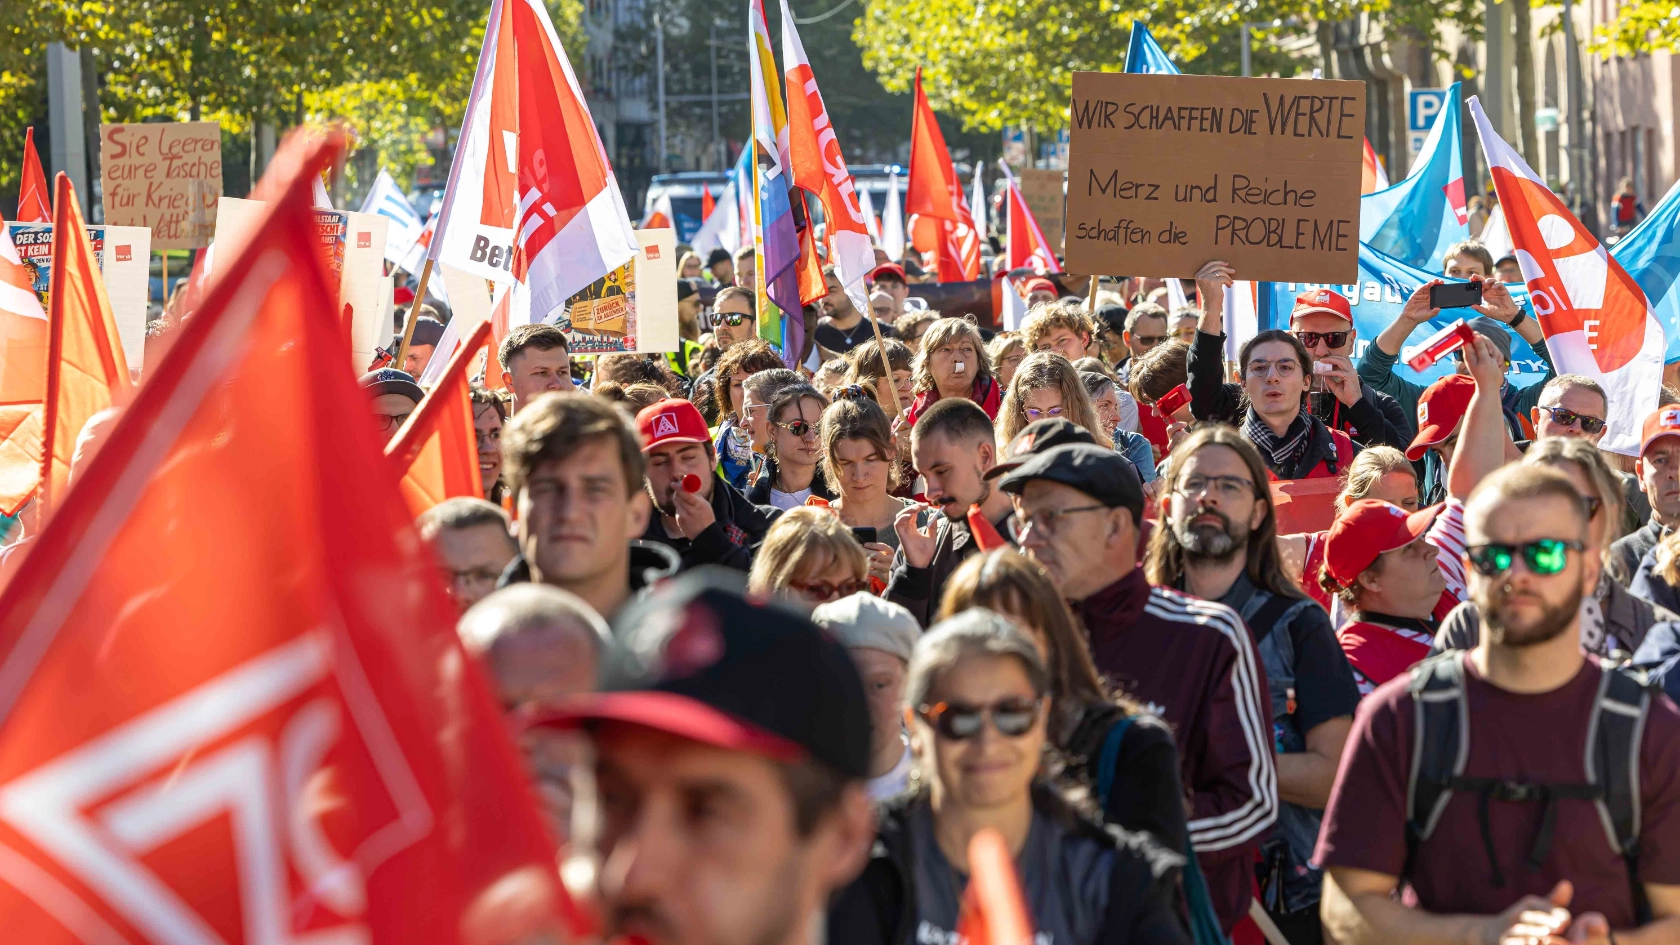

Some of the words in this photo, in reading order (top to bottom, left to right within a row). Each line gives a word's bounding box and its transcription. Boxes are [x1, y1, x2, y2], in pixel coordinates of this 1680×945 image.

[1072, 99, 1119, 129] WIR
[1123, 103, 1223, 133] SCHAFFEN
[1228, 108, 1260, 135] DIE
[1262, 92, 1357, 139] WERTE
[1416, 94, 1440, 128] P
[107, 127, 149, 160] Sie
[108, 162, 157, 181] eure
[1088, 168, 1161, 201] Merz
[1174, 174, 1218, 203] und
[1231, 174, 1317, 207] Reiche
[109, 183, 140, 210] für
[16, 234, 35, 245] DER
[28, 245, 49, 255] KEIN
[1075, 218, 1151, 246] schaffen
[1158, 220, 1189, 246] die
[1214, 215, 1351, 252] PROBLEME
